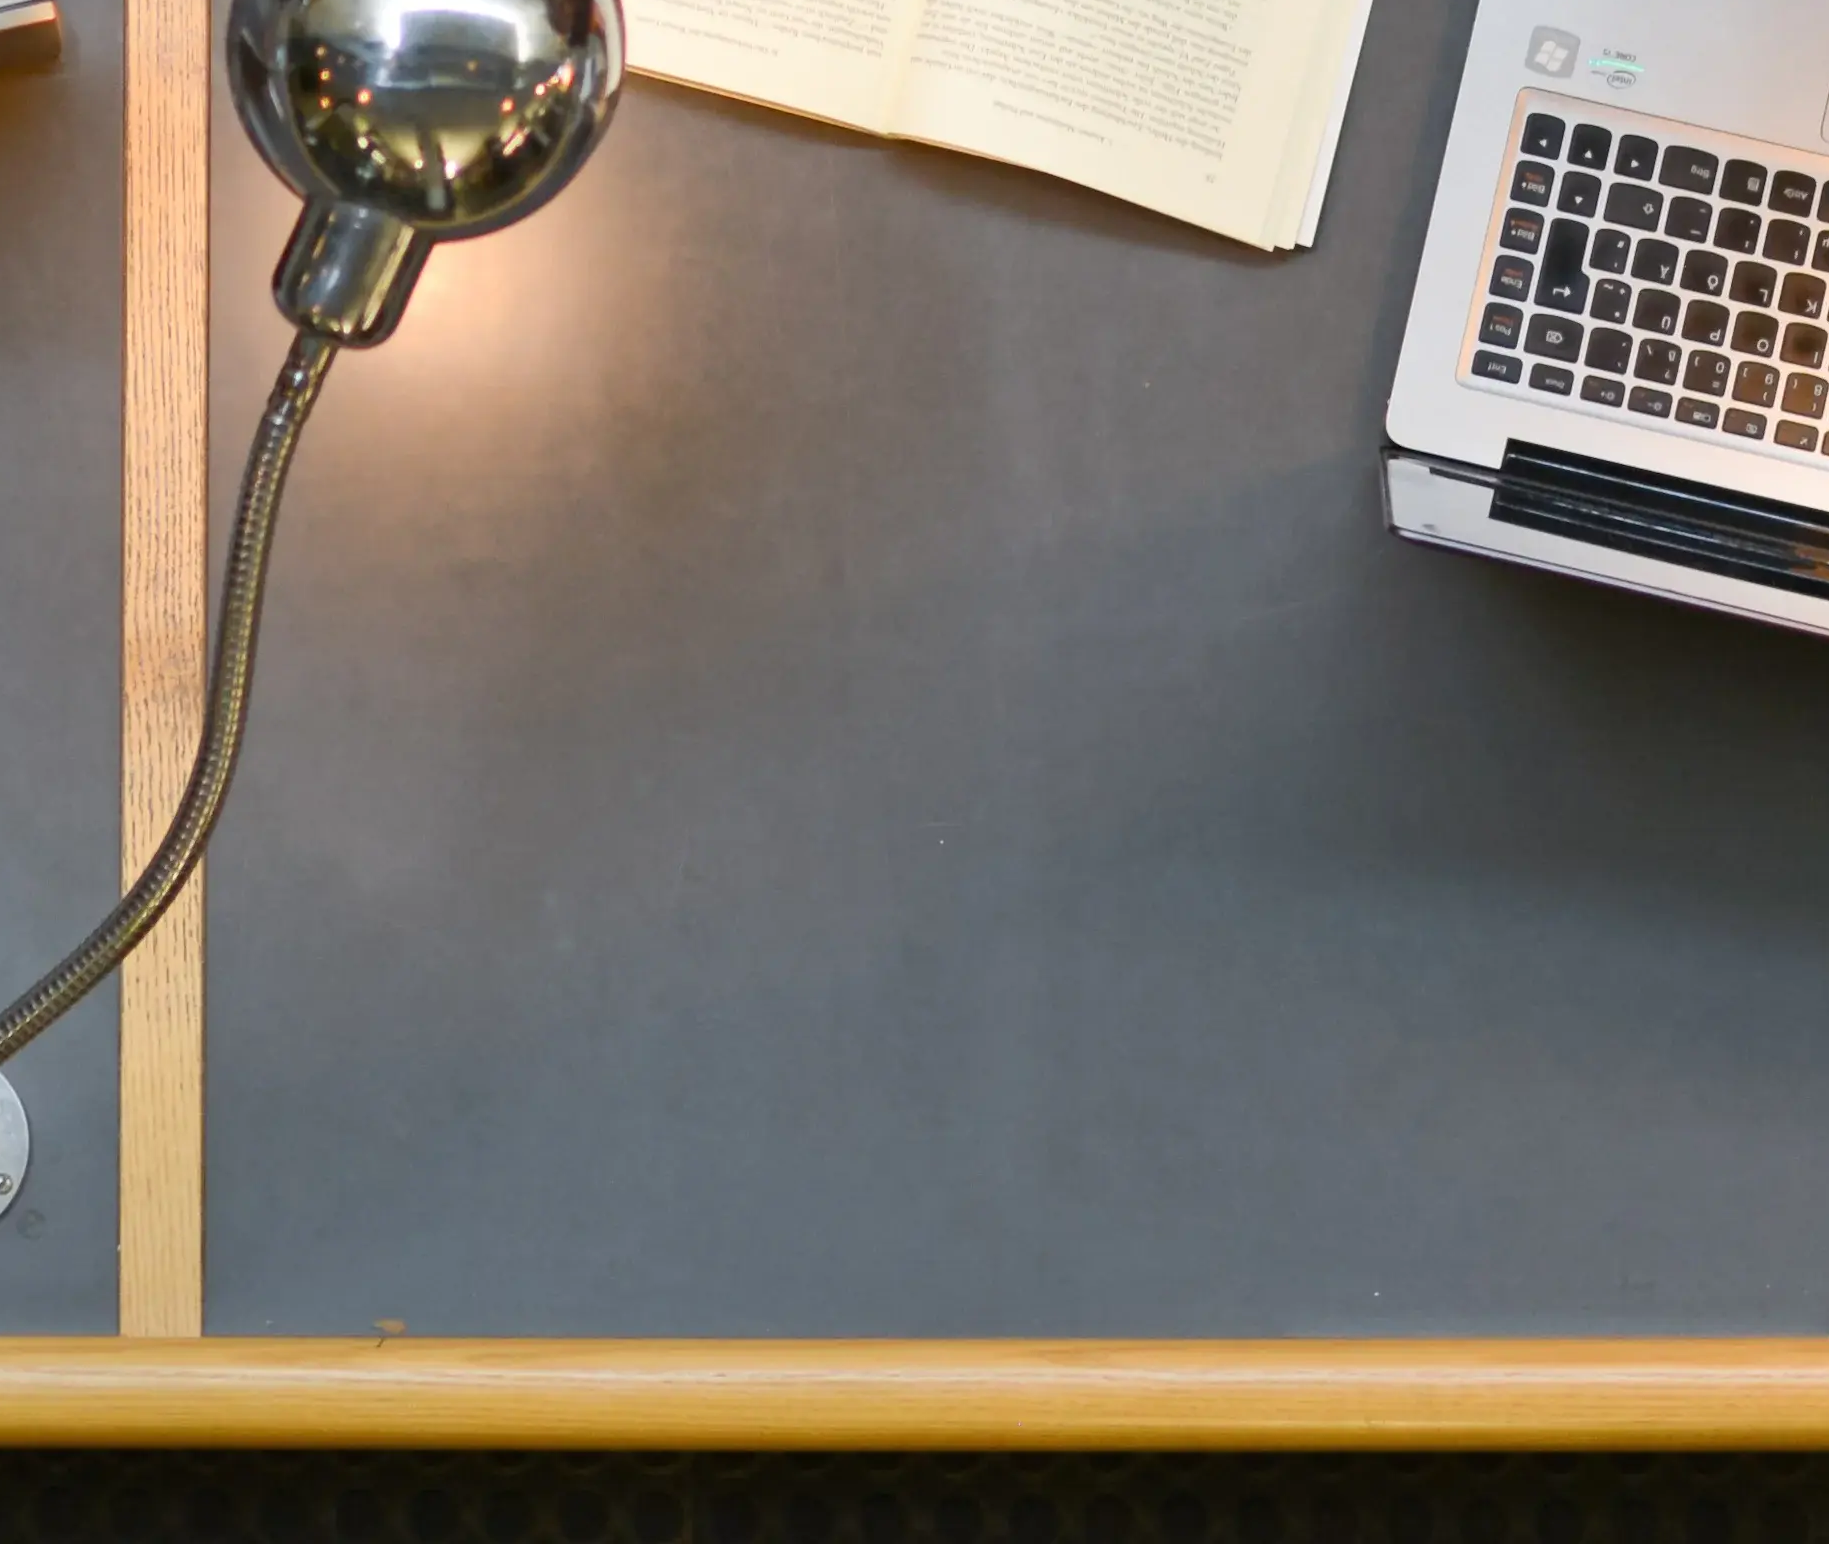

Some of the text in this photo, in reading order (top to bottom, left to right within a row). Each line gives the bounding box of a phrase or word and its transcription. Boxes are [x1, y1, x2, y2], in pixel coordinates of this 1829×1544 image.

[1615, 51, 1636, 61] CORE
[1610, 74, 1632, 84] intel
[1689, 164, 1710, 178] Strg
[1526, 181, 1545, 194] Bild
[1516, 228, 1535, 240] Bild
[1659, 264, 1670, 279] Ä
[1500, 275, 1523, 289] Ende
[1758, 287, 1768, 302] L
[1805, 299, 1817, 313] K
[1660, 315, 1671, 329] Ü
[1494, 323, 1511, 336] Pos
[1708, 328, 1721, 341] P
[1755, 338, 1769, 352] O
[1486, 362, 1507, 374] Entf
[1764, 372, 1773, 384] 9
[1813, 383, 1823, 396] 8
